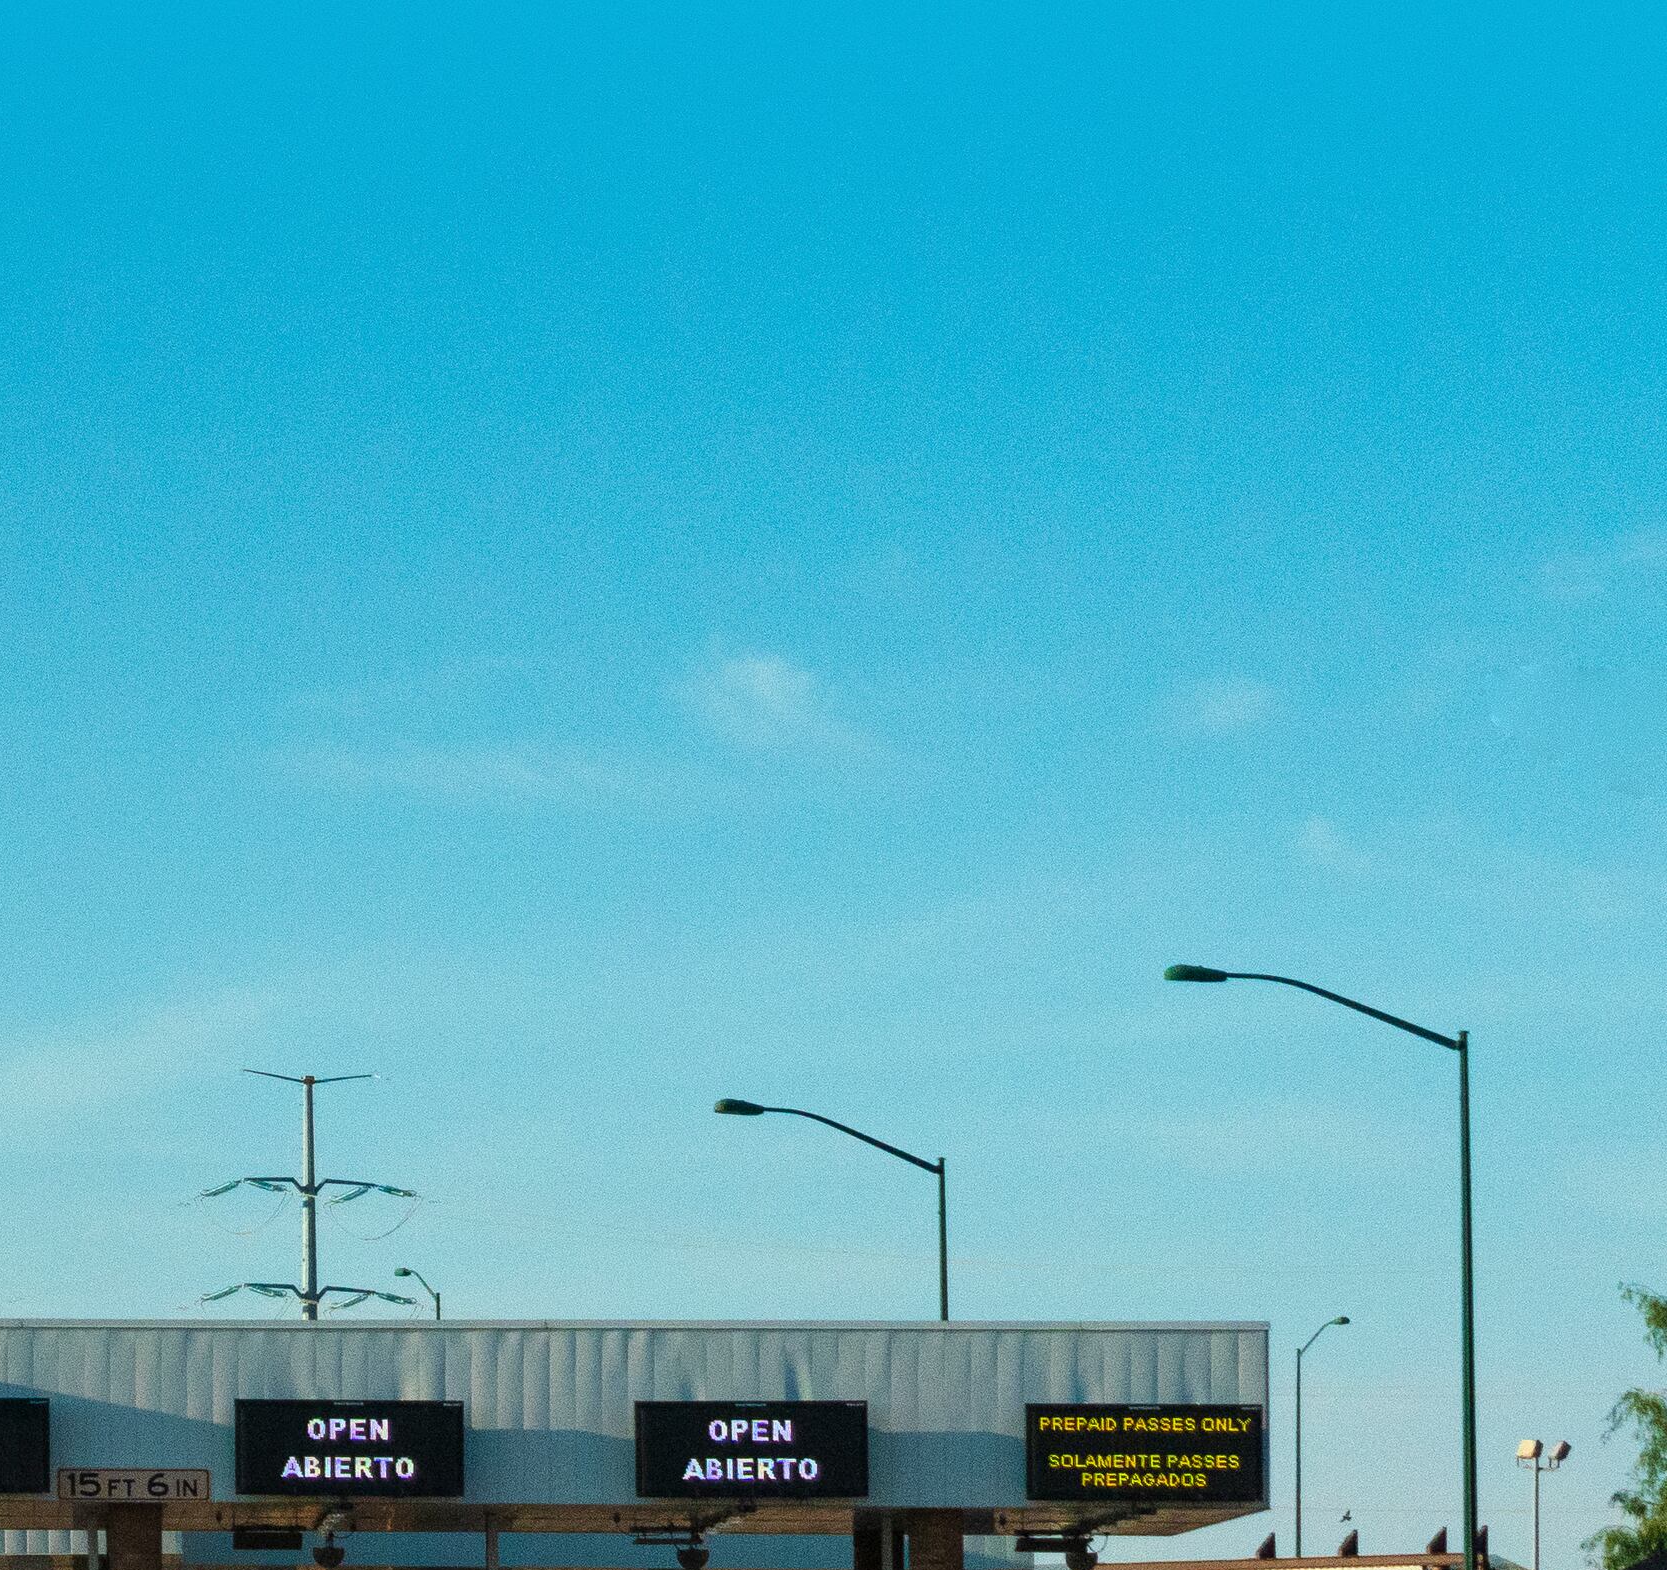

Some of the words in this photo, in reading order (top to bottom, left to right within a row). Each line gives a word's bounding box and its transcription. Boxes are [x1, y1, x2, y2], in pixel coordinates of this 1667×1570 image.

[307, 1418, 390, 1440] OPEN
[708, 1419, 792, 1442] OPEN
[1039, 1417, 1117, 1431] PREPAID
[1123, 1417, 1196, 1432] PASSES
[1201, 1418, 1251, 1432] ONLY
[280, 1456, 415, 1479] ABIERTO
[681, 1458, 818, 1480] ABIERTO
[1048, 1454, 1161, 1468] SOLAMENTE
[1166, 1454, 1240, 1469] PASSES
[68, 1472, 102, 1497] 15
[108, 1479, 136, 1497] FT
[147, 1473, 169, 1497] 6
[176, 1479, 198, 1497] IN
[1081, 1472, 1207, 1487] PREPAGADOS
